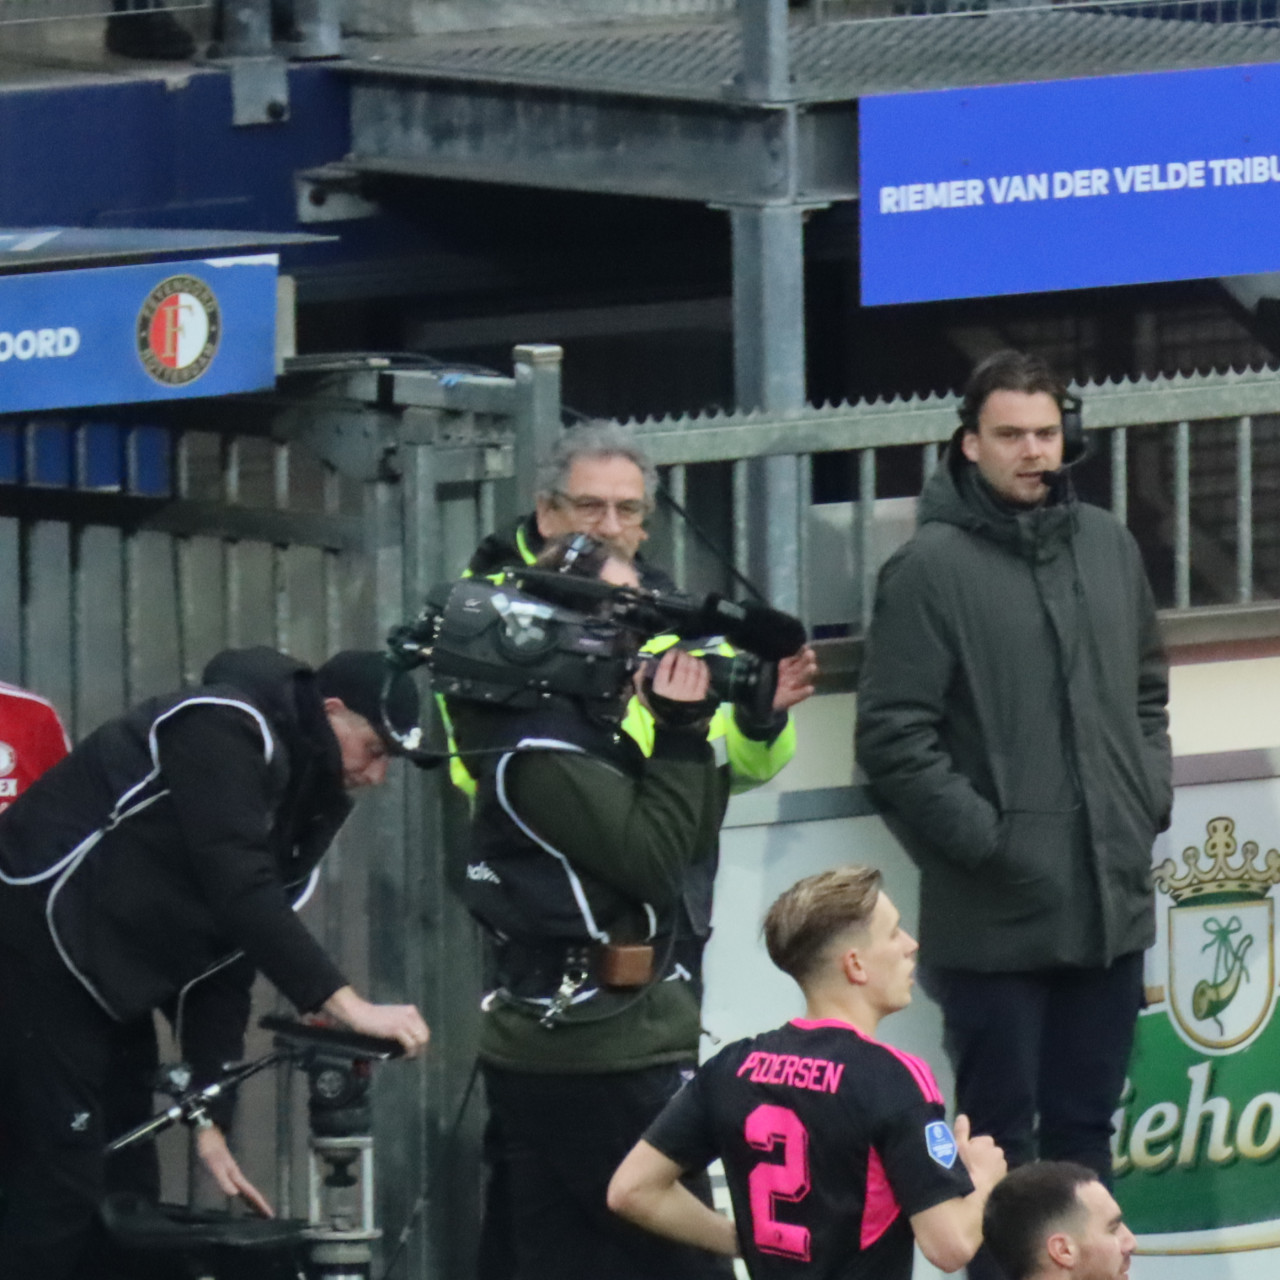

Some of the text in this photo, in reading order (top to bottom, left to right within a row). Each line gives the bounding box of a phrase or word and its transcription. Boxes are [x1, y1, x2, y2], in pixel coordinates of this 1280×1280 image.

[879, 178, 985, 214] RIEMER
[987, 173, 1049, 204] VAN
[1052, 168, 1110, 199] DER
[1113, 160, 1206, 194] VELDE
[0, 327, 80, 361] OORD
[743, 1103, 811, 1263] 2
